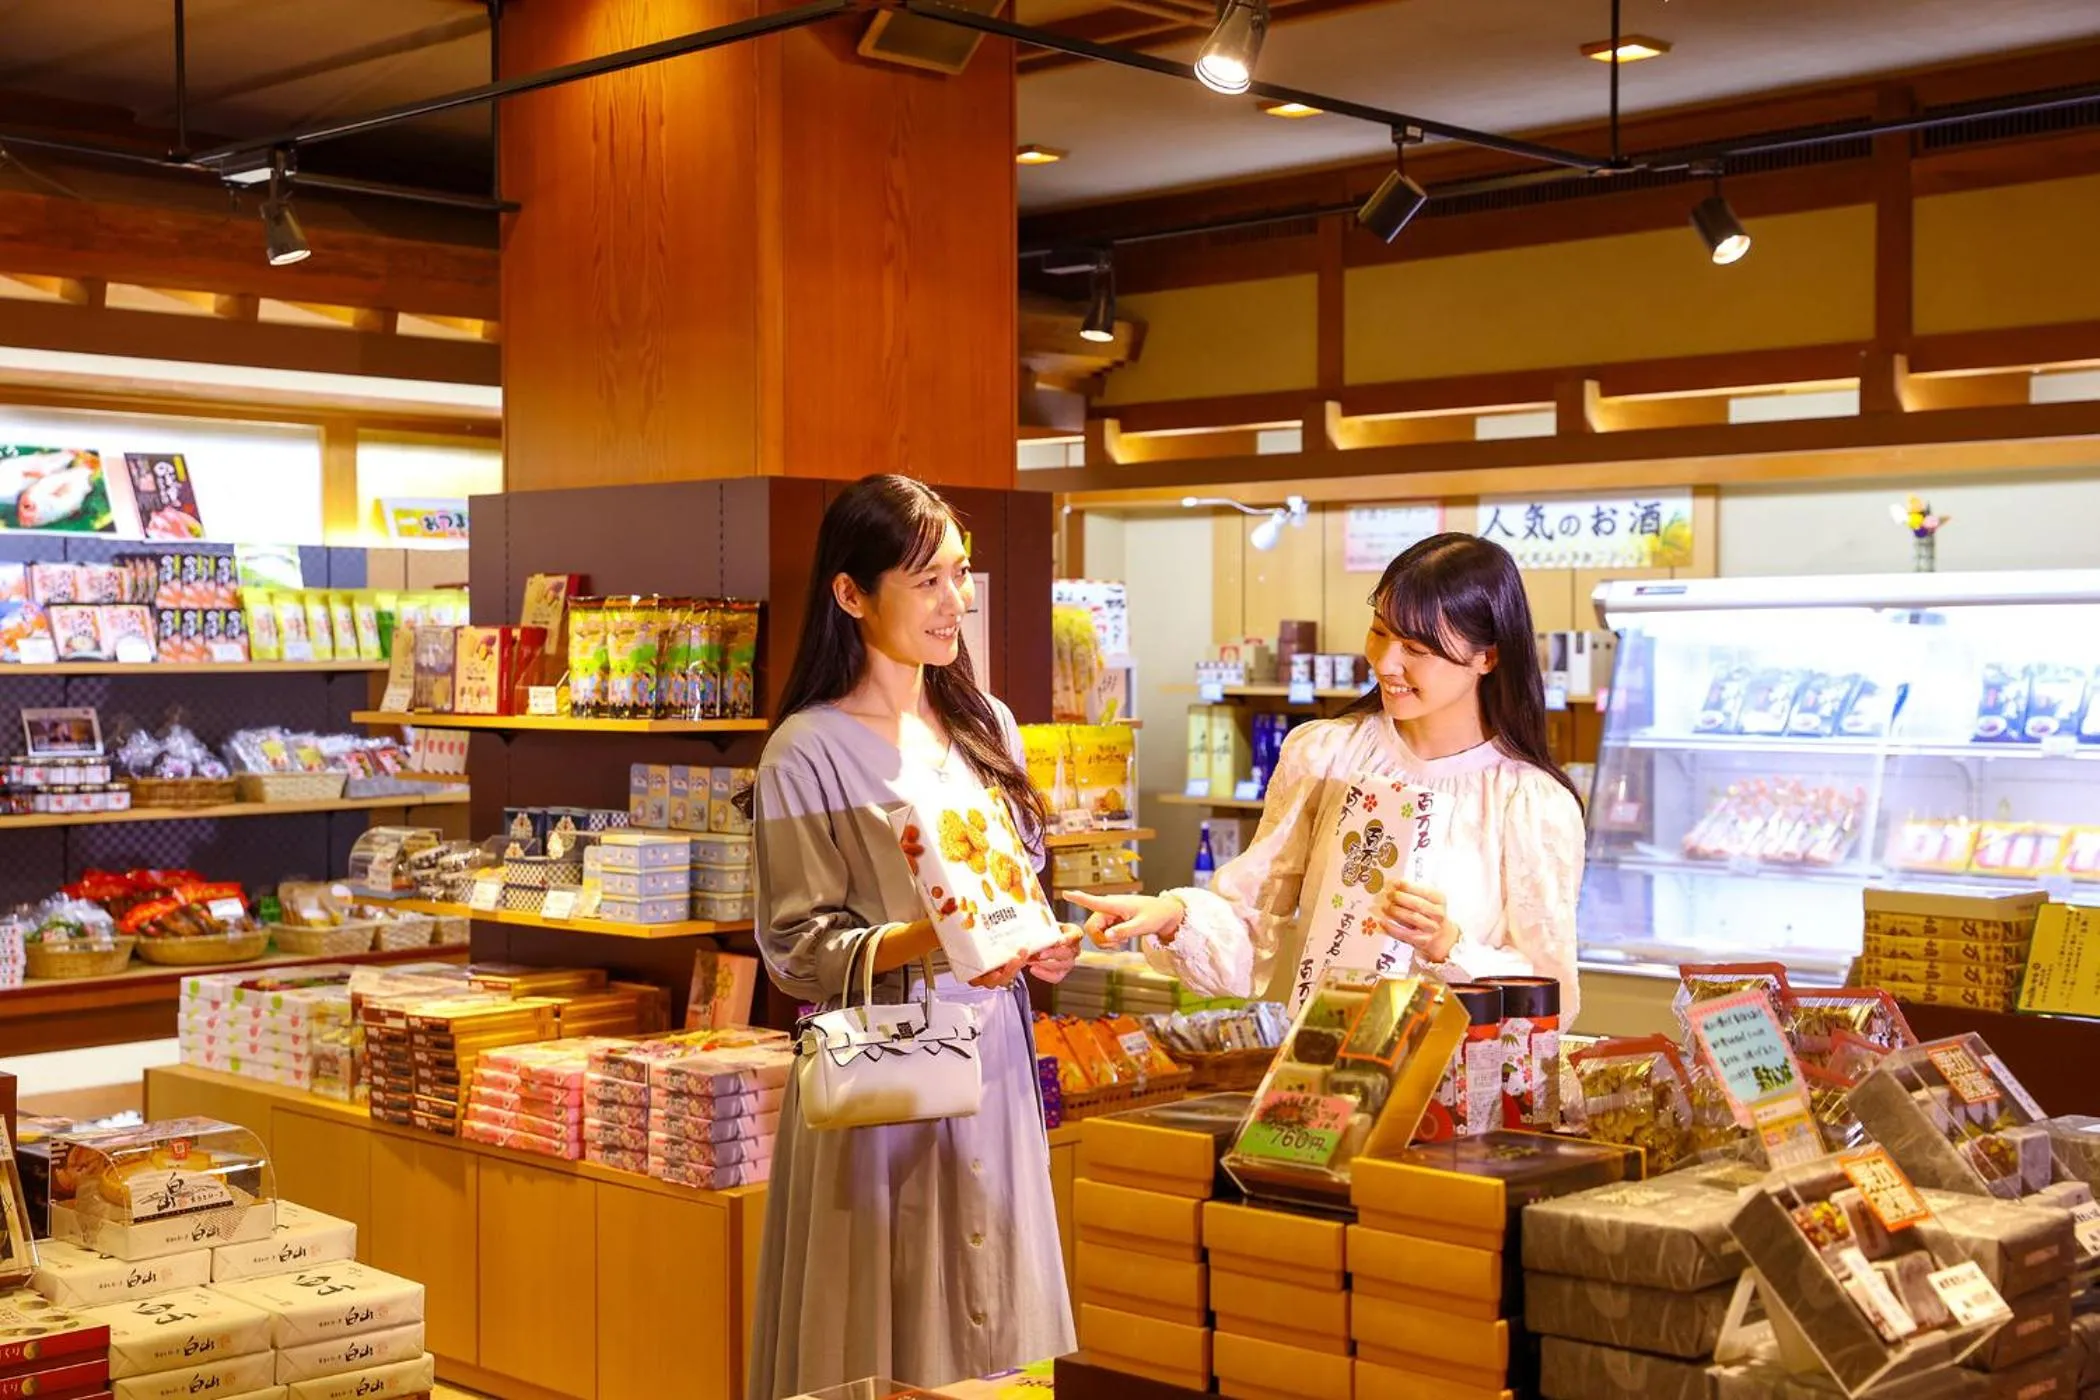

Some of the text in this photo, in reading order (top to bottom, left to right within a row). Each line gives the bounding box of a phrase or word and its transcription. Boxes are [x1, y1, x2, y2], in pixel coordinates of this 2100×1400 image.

[1484, 502, 1661, 541] 人気のお酒
[1336, 786, 1363, 836] 百万
[1270, 1129, 1326, 1150] 760円
[157, 1172, 185, 1212] 白山
[192, 1223, 220, 1242] 白山
[279, 1244, 306, 1262] 白山
[127, 1268, 156, 1288] 白山
[294, 1275, 356, 1296] 白山
[132, 1303, 198, 1325] 白山
[346, 1306, 373, 1326] 白山
[184, 1336, 214, 1356] 白山
[346, 1342, 373, 1362] 白山
[189, 1373, 220, 1394] 白山
[356, 1377, 384, 1397] 白山
